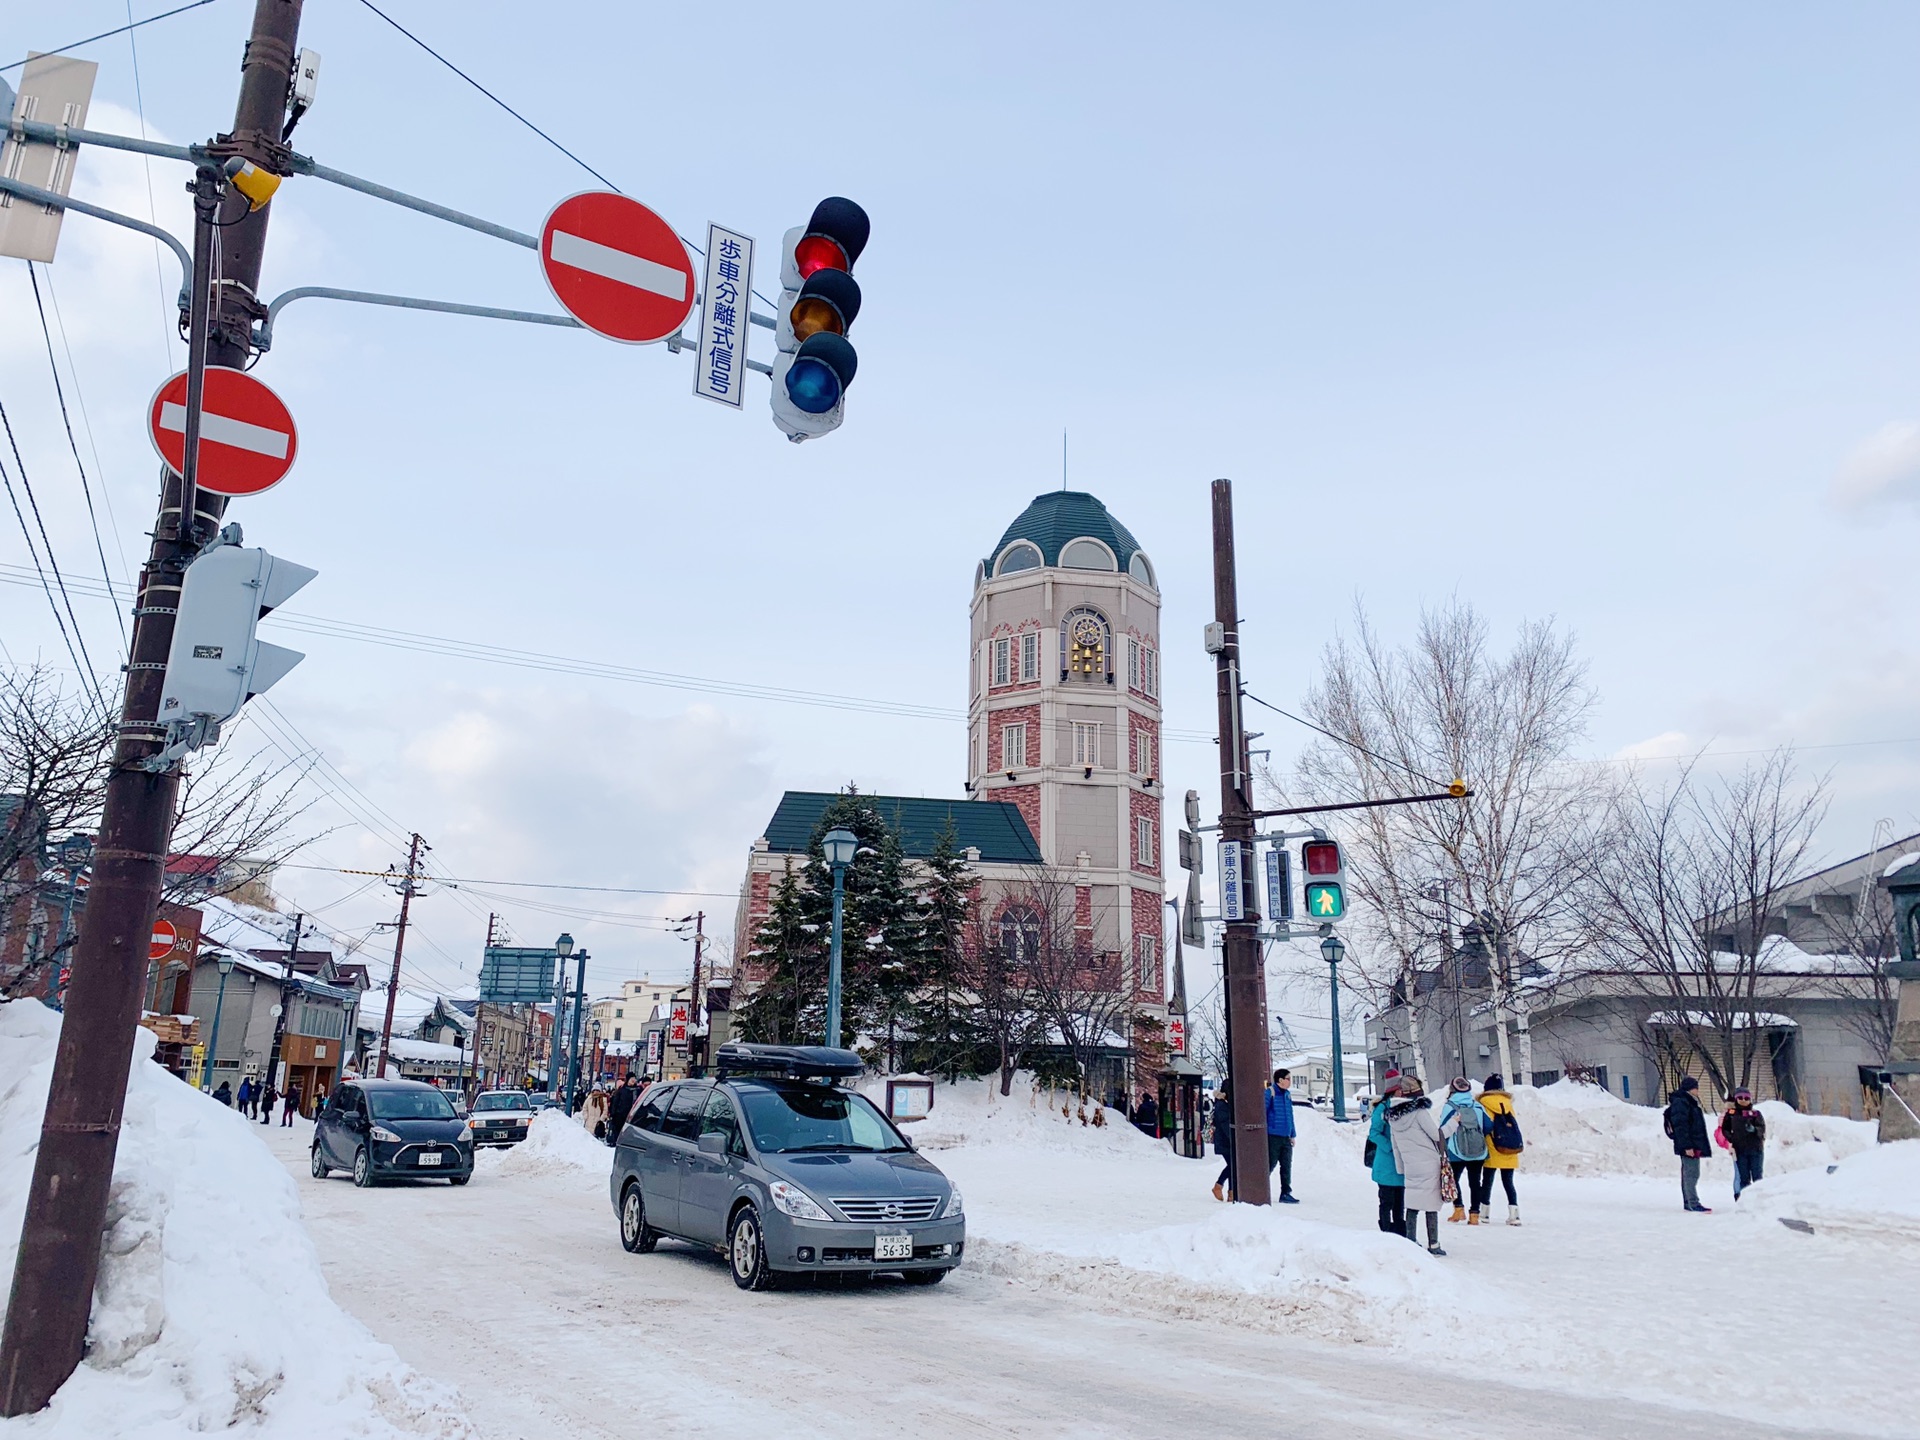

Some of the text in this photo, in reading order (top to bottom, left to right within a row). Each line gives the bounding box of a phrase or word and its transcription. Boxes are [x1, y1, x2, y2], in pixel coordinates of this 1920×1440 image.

[708, 238, 741, 394] 歩車分離式信号
[1223, 844, 1239, 918] 歩車分離信号
[671, 1006, 687, 1040] 地酒
[1169, 1019, 1184, 1051] 地酒
